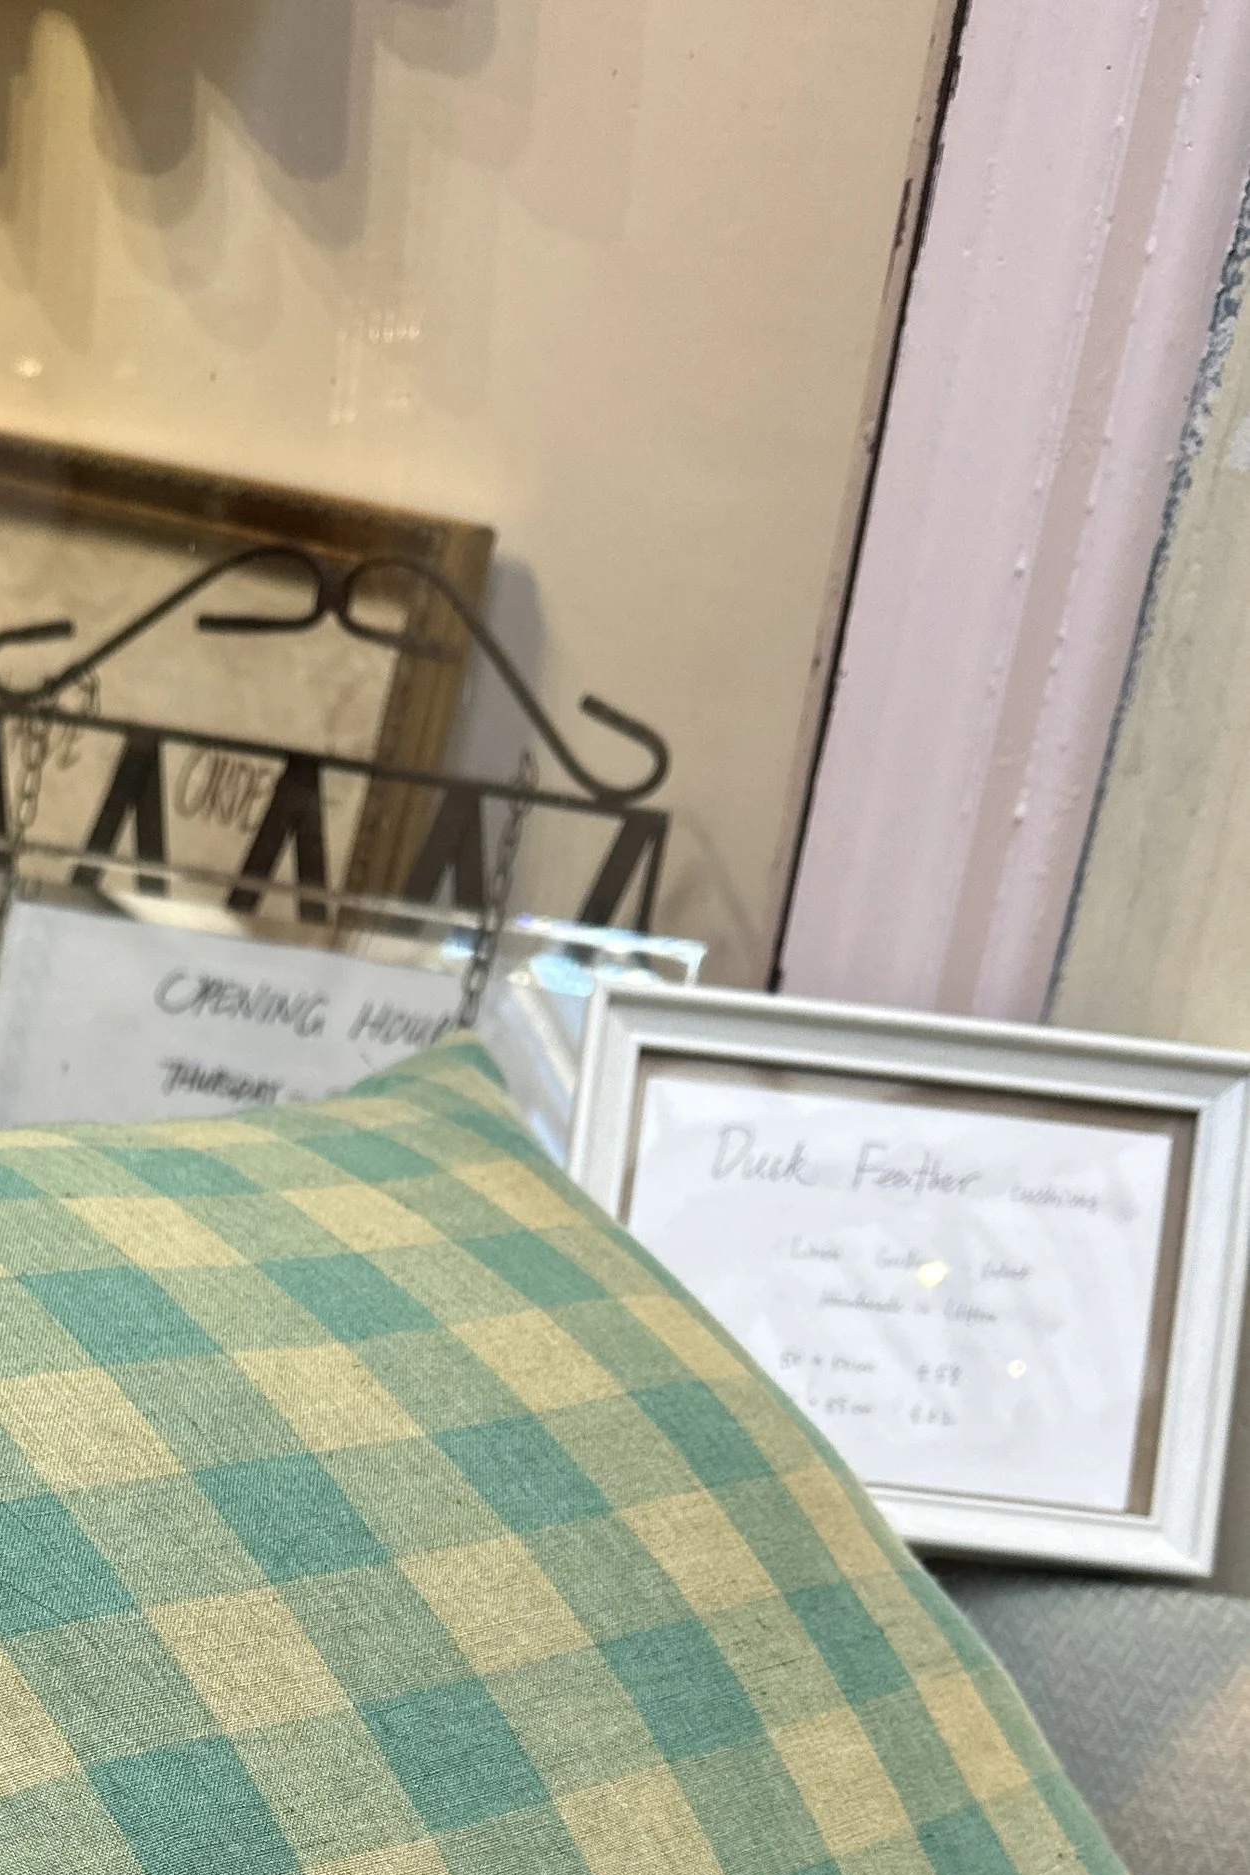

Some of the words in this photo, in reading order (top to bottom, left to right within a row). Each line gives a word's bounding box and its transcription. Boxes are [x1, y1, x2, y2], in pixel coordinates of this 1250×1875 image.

[154, 964, 330, 1039] OPENING
[710, 1121, 816, 1188] Duck
[851, 1137, 983, 1196] Feather
